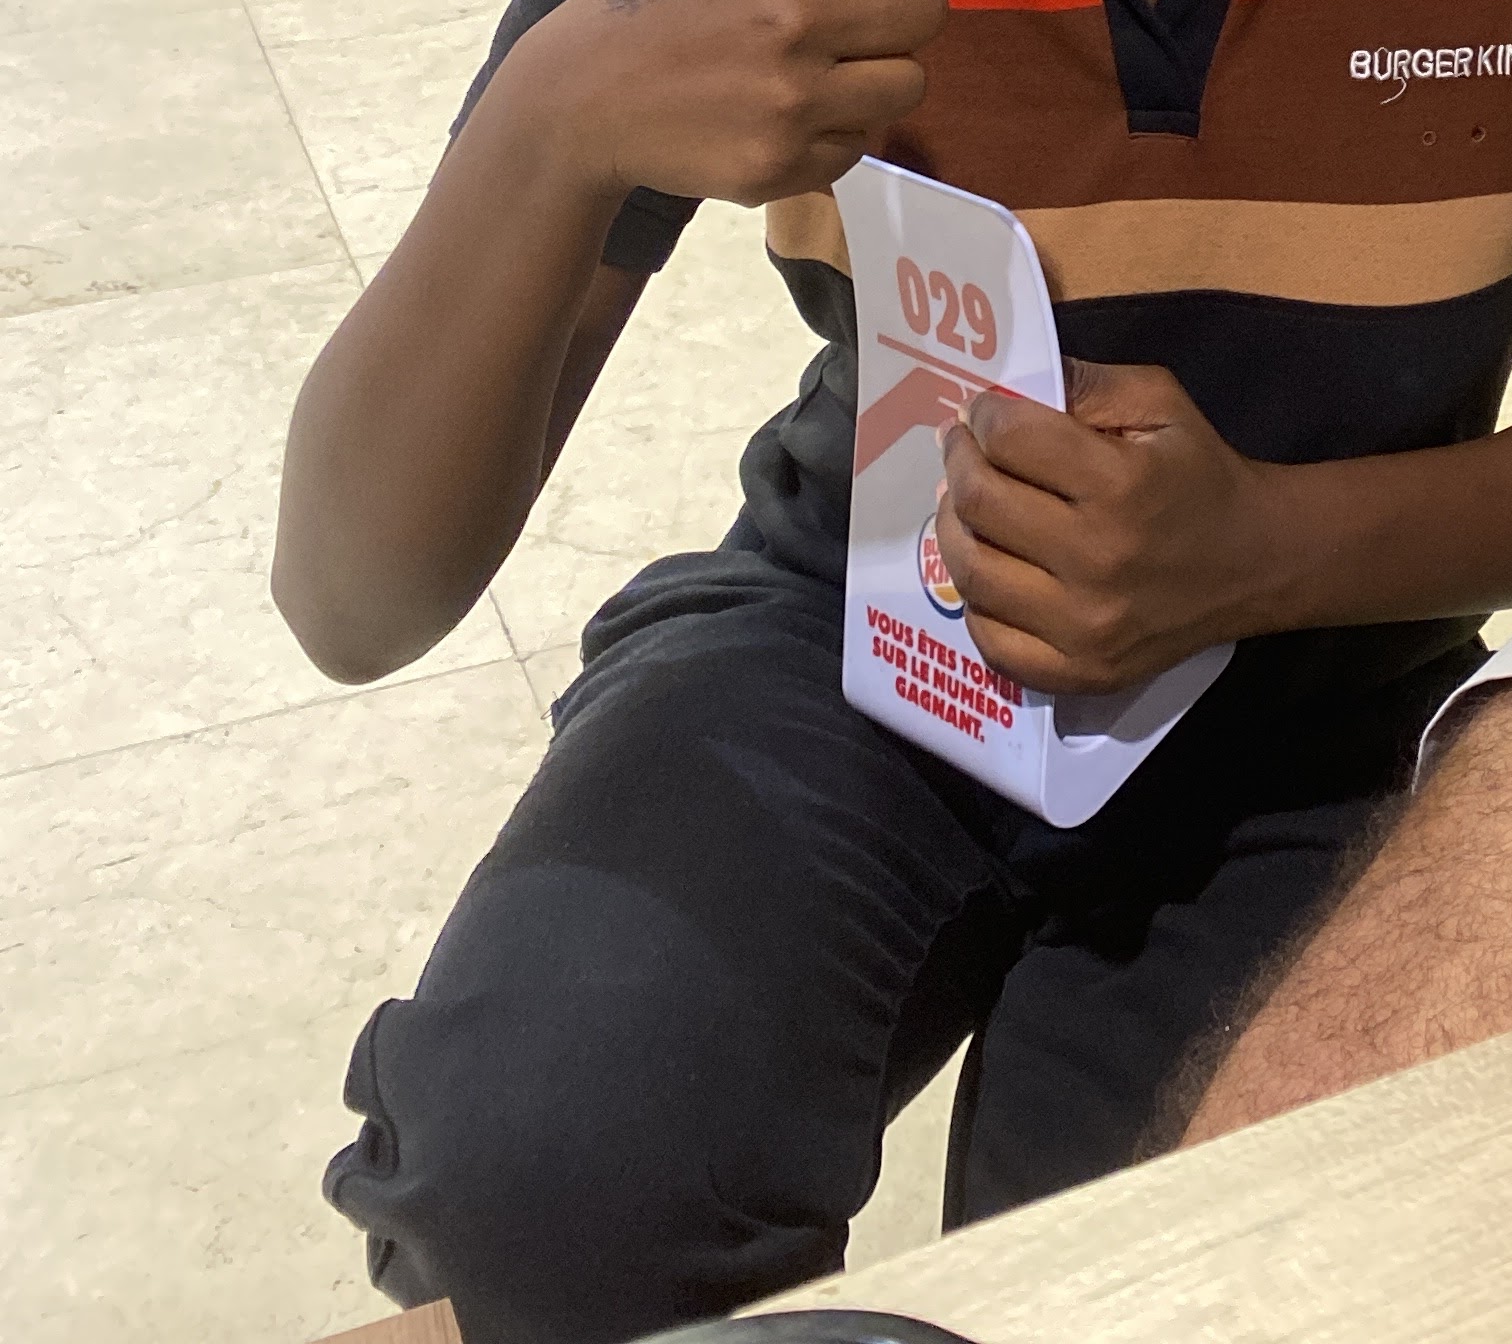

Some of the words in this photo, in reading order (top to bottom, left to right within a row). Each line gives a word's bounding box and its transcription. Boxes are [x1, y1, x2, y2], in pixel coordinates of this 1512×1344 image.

[1349, 46, 1474, 82] BURGER
[896, 255, 998, 362] 029
[866, 604, 914, 648] VOUS
[918, 628, 957, 671] ÊTES
[872, 635, 907, 673] SUR
[910, 655, 930, 685] LE
[933, 667, 1014, 730] NUMÉRO
[894, 675, 986, 744] GAGNANT.
